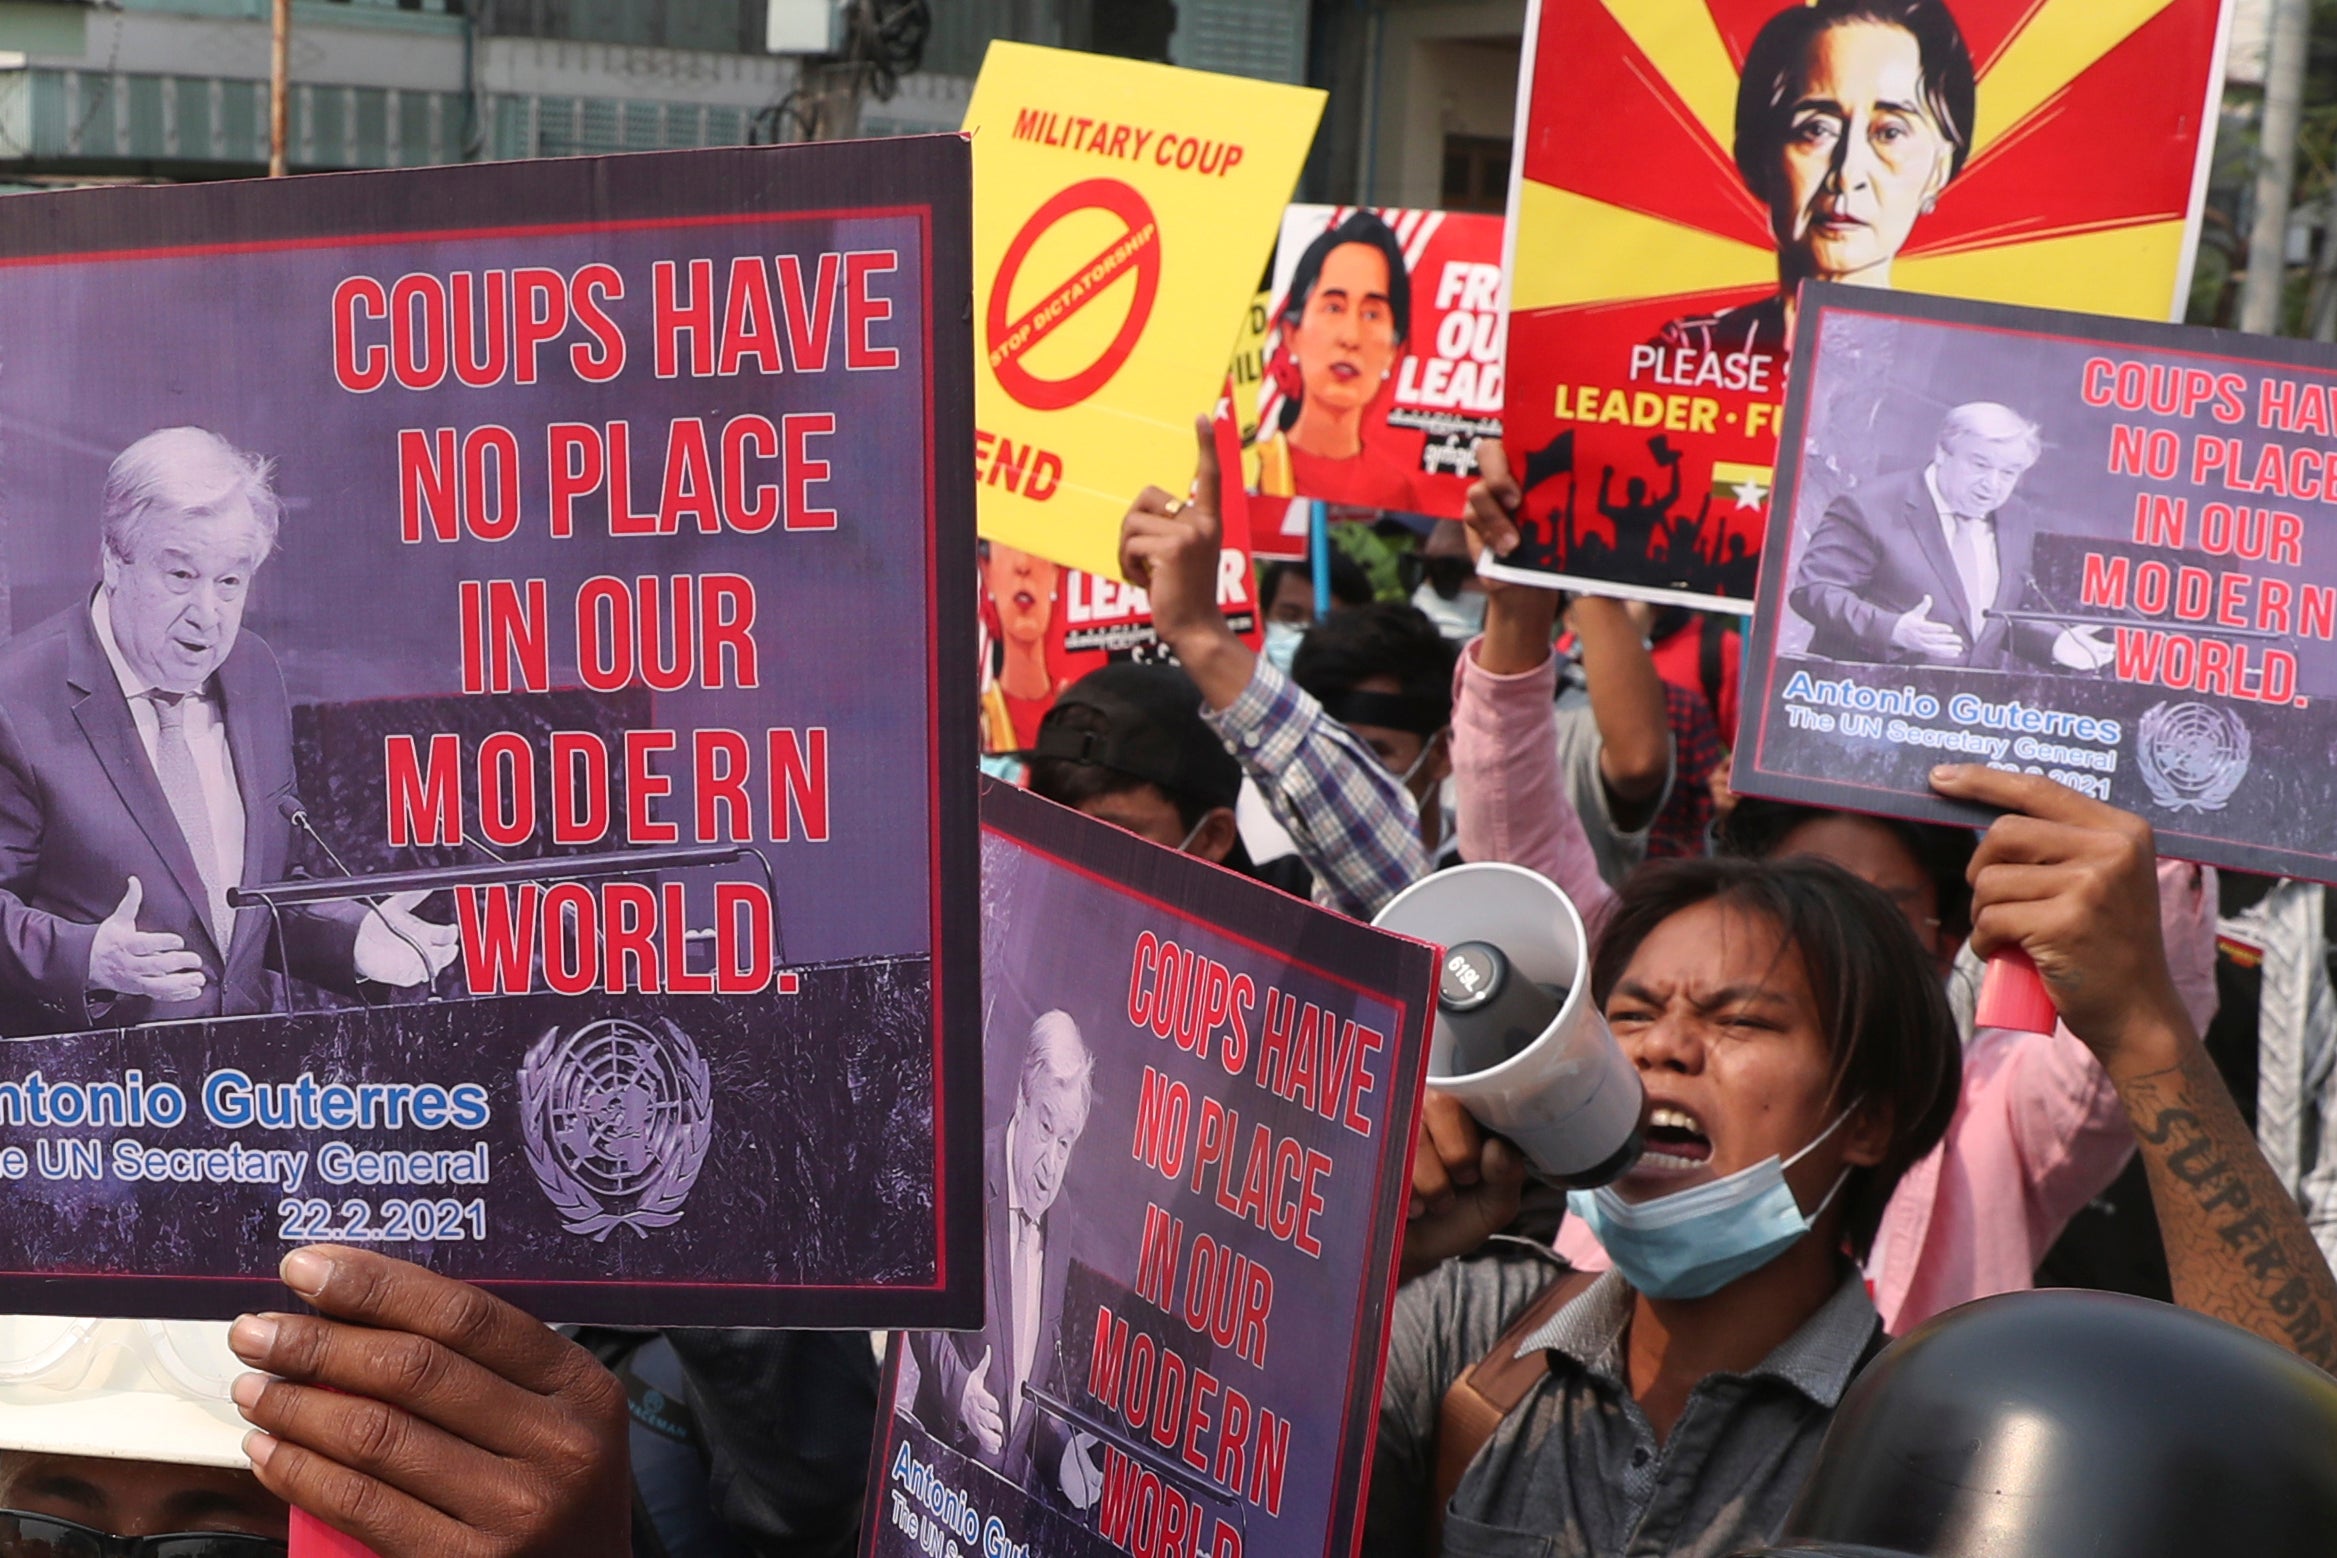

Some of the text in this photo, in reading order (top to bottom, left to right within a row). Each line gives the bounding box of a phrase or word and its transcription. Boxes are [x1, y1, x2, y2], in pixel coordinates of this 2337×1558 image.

[1011, 107, 1244, 177] MILITARY COUP
[331, 250, 900, 394] COUPS HAVE
[989, 222, 1156, 368] STOP DICTATORSHIP
[1435, 260, 1502, 311] FR
[1436, 311, 1502, 365] OU
[1629, 344, 1774, 393] PLEASE
[1394, 355, 1504, 411] LEAD
[1553, 384, 1721, 435] LEADER
[2080, 357, 2337, 438] COUPS HA
[398, 412, 838, 544] NO PLACE
[2108, 424, 2180, 481] NO
[2133, 493, 2304, 566] IN OUR
[458, 572, 760, 695] IN OUR
[2080, 553, 2335, 641] MODERN
[2115, 625, 2309, 709] WORLD.
[1783, 671, 2123, 745] Antonio Guterres
[1785, 704, 2116, 773] The UN Secretary General
[384, 727, 830, 848] MODERN
[454, 880, 802, 997] WORLD.
[1127, 930, 1384, 1137] COUPS HAVE
[0, 1068, 491, 1130] ntonio Guterres
[36, 1139, 102, 1181] UN
[112, 1138, 308, 1193] Secretary
[317, 1141, 490, 1185] General
[1132, 1064, 1333, 1259] NO PLACE
[278, 1198, 487, 1242] 22.2.2021
[1135, 1201, 1274, 1370] IN OUR
[1087, 1304, 1290, 1518] MODERN
[891, 1439, 979, 1546] Antonio
[891, 1491, 919, 1540] The
